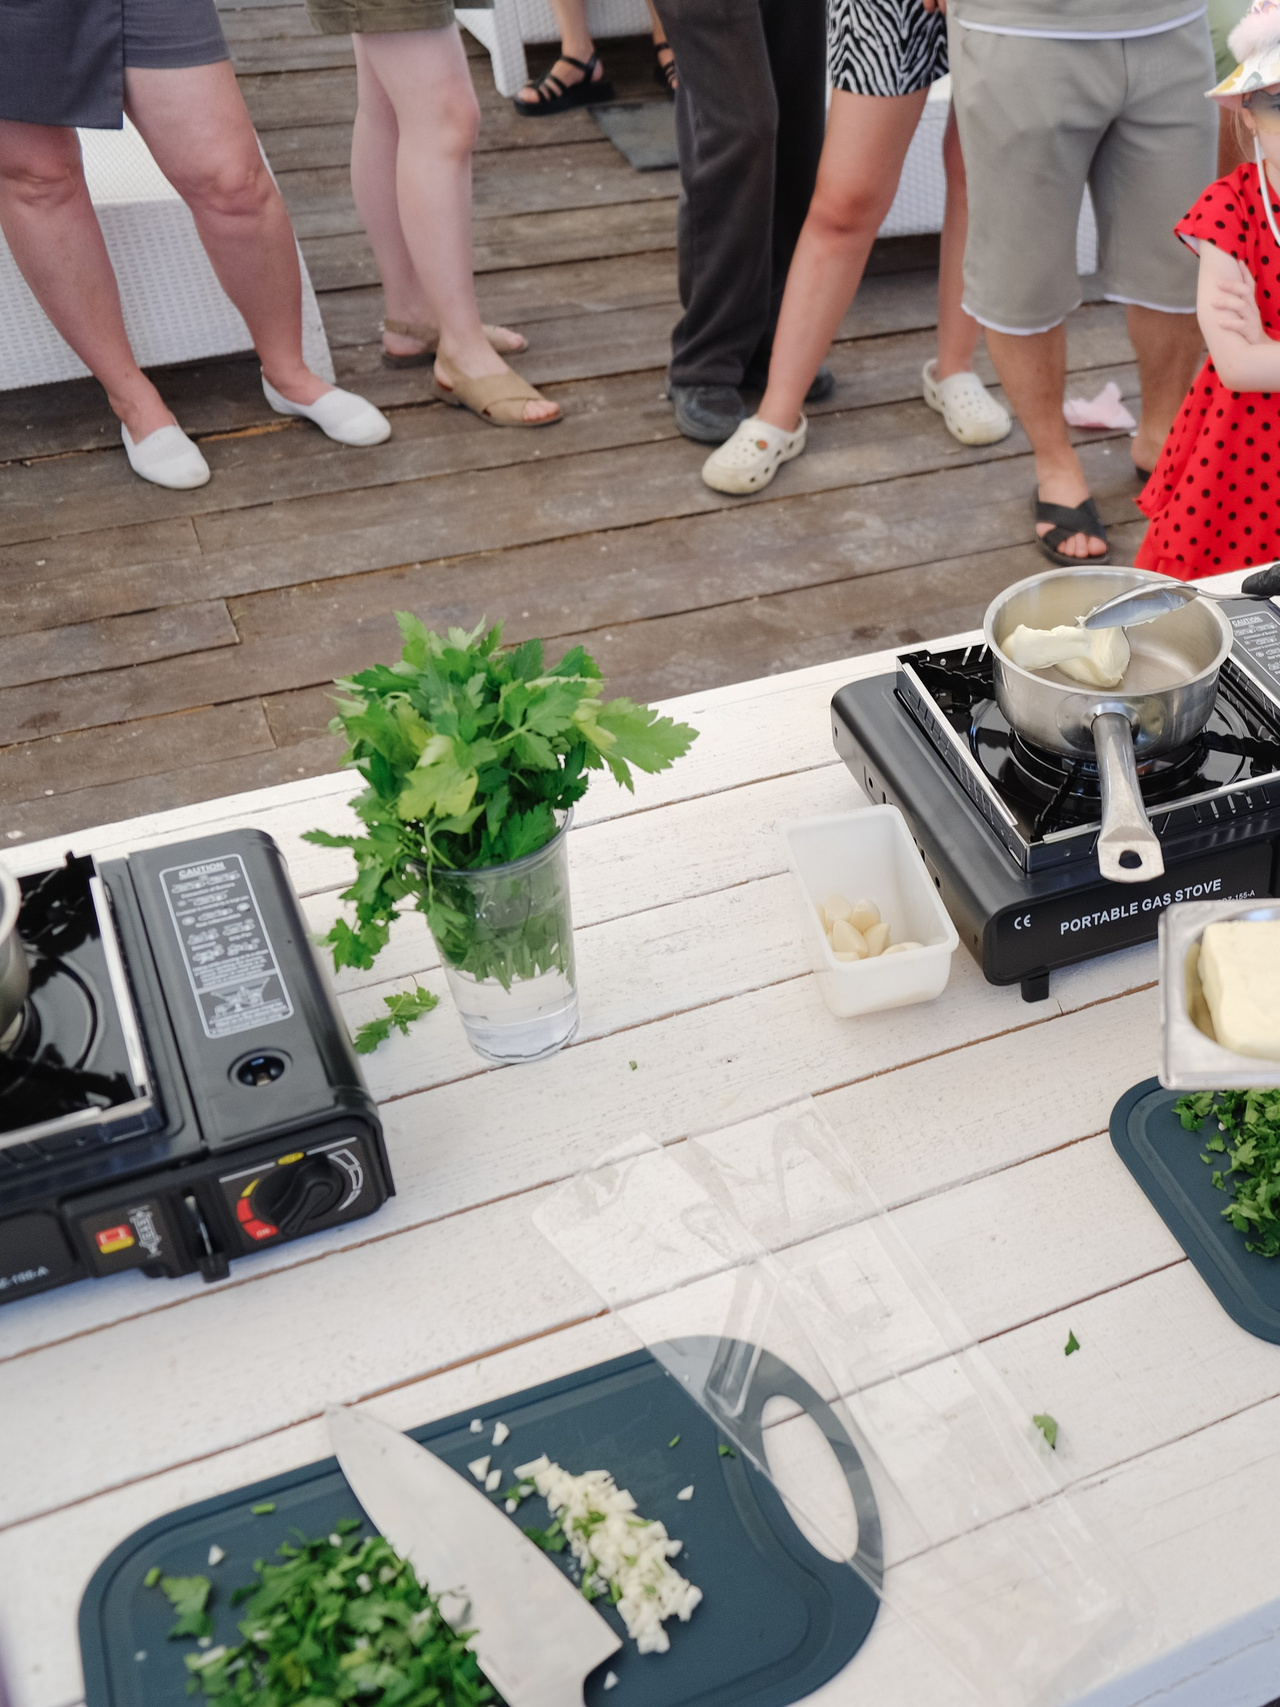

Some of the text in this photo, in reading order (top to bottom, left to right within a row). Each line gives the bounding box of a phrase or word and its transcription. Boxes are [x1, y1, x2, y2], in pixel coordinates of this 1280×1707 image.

[179, 861, 226, 880] CAUTION
[1060, 879, 1222, 935] PORTABLE GAS STOVE
